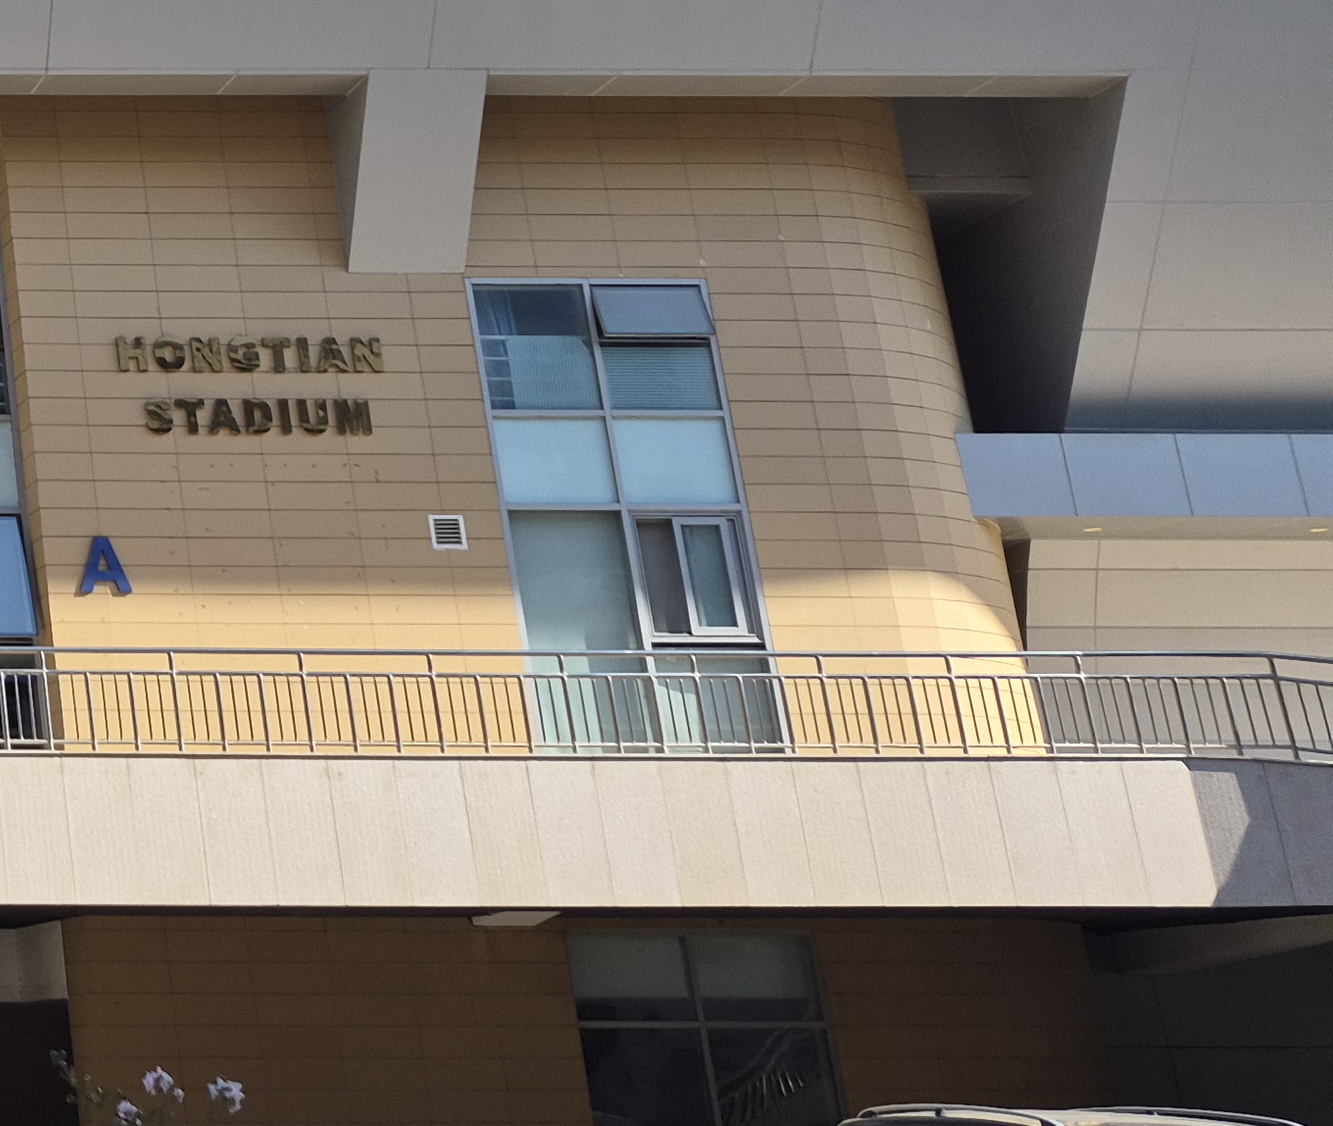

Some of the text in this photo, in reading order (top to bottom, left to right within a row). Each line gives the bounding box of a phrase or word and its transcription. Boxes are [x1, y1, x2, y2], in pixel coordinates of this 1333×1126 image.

[115, 335, 385, 373] HONGTIAN
[144, 397, 373, 436] STADIUM
[74, 535, 132, 598] A
